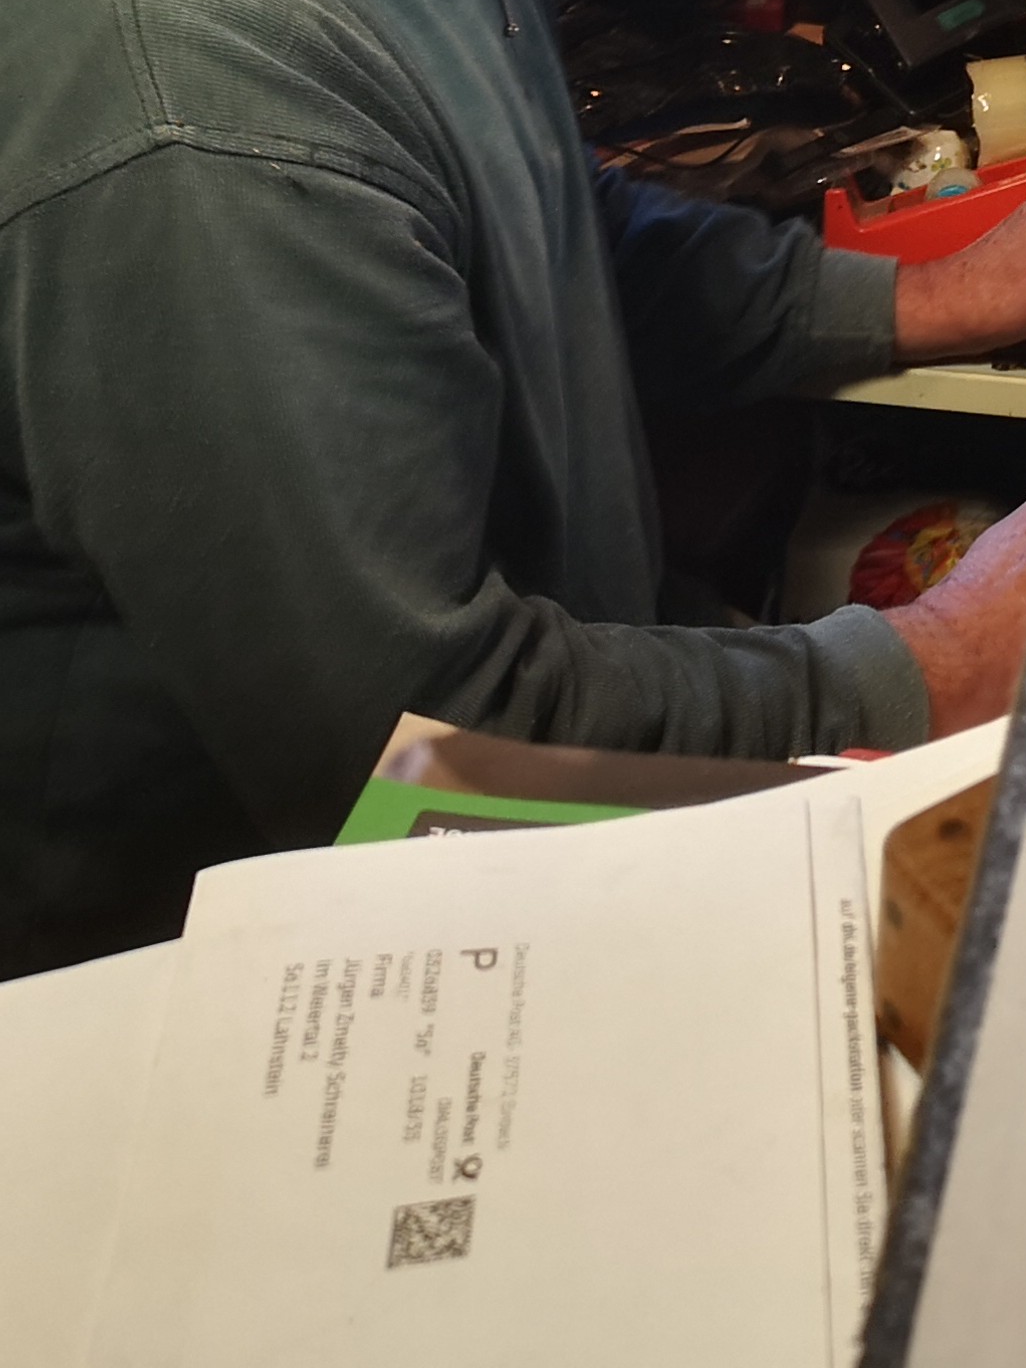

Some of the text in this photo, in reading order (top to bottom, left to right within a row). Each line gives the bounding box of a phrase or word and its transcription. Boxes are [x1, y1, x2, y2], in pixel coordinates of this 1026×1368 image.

[336, 958, 362, 1014] Jürgen
[370, 953, 393, 999] Firma
[460, 947, 498, 971] P
[262, 1017, 292, 1099] Lahnstein
[314, 1070, 346, 1171] Schreinerei
[462, 1050, 485, 1147] Deutsche Post
[853, 1121, 869, 1187] scannen
